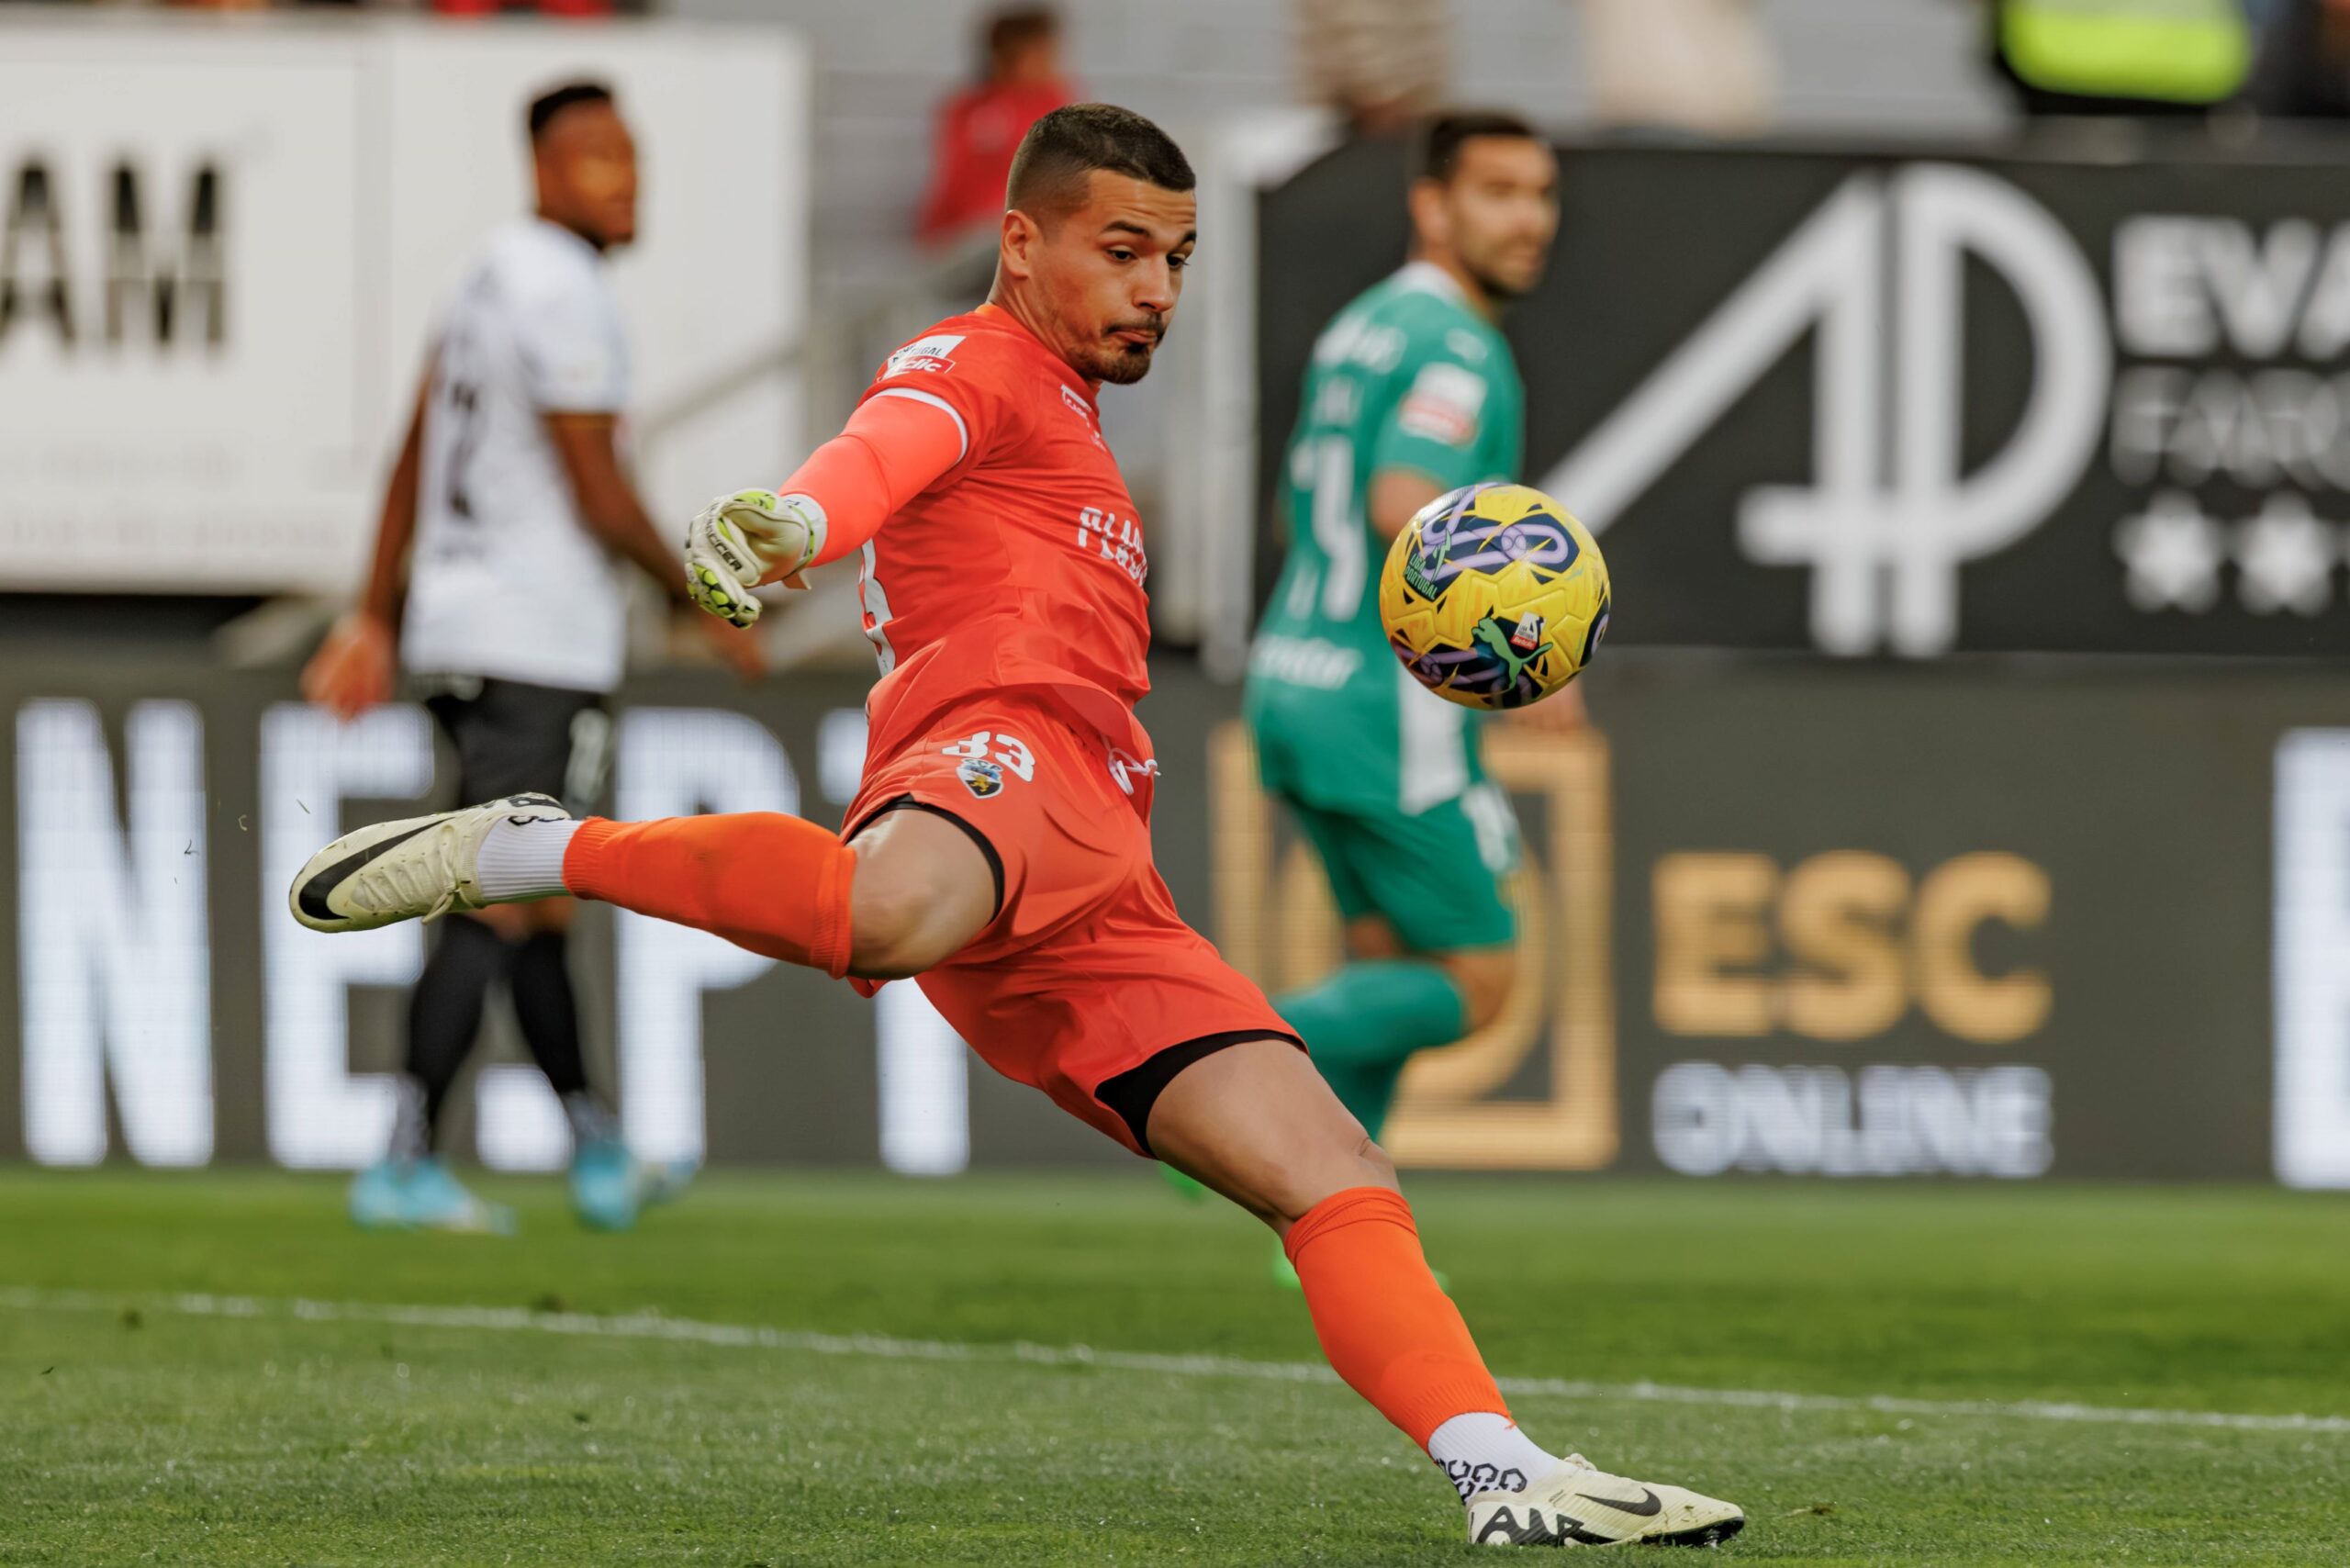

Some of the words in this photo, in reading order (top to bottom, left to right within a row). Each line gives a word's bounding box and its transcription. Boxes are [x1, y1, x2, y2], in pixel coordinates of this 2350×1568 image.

[1404, 565, 1438, 600] PORTUGAL
[1410, 553, 1427, 573] LIGA
[942, 731, 1036, 782] 33
[1654, 850, 2053, 1043] ESC
[1654, 1061, 2053, 1179] ONLINE
